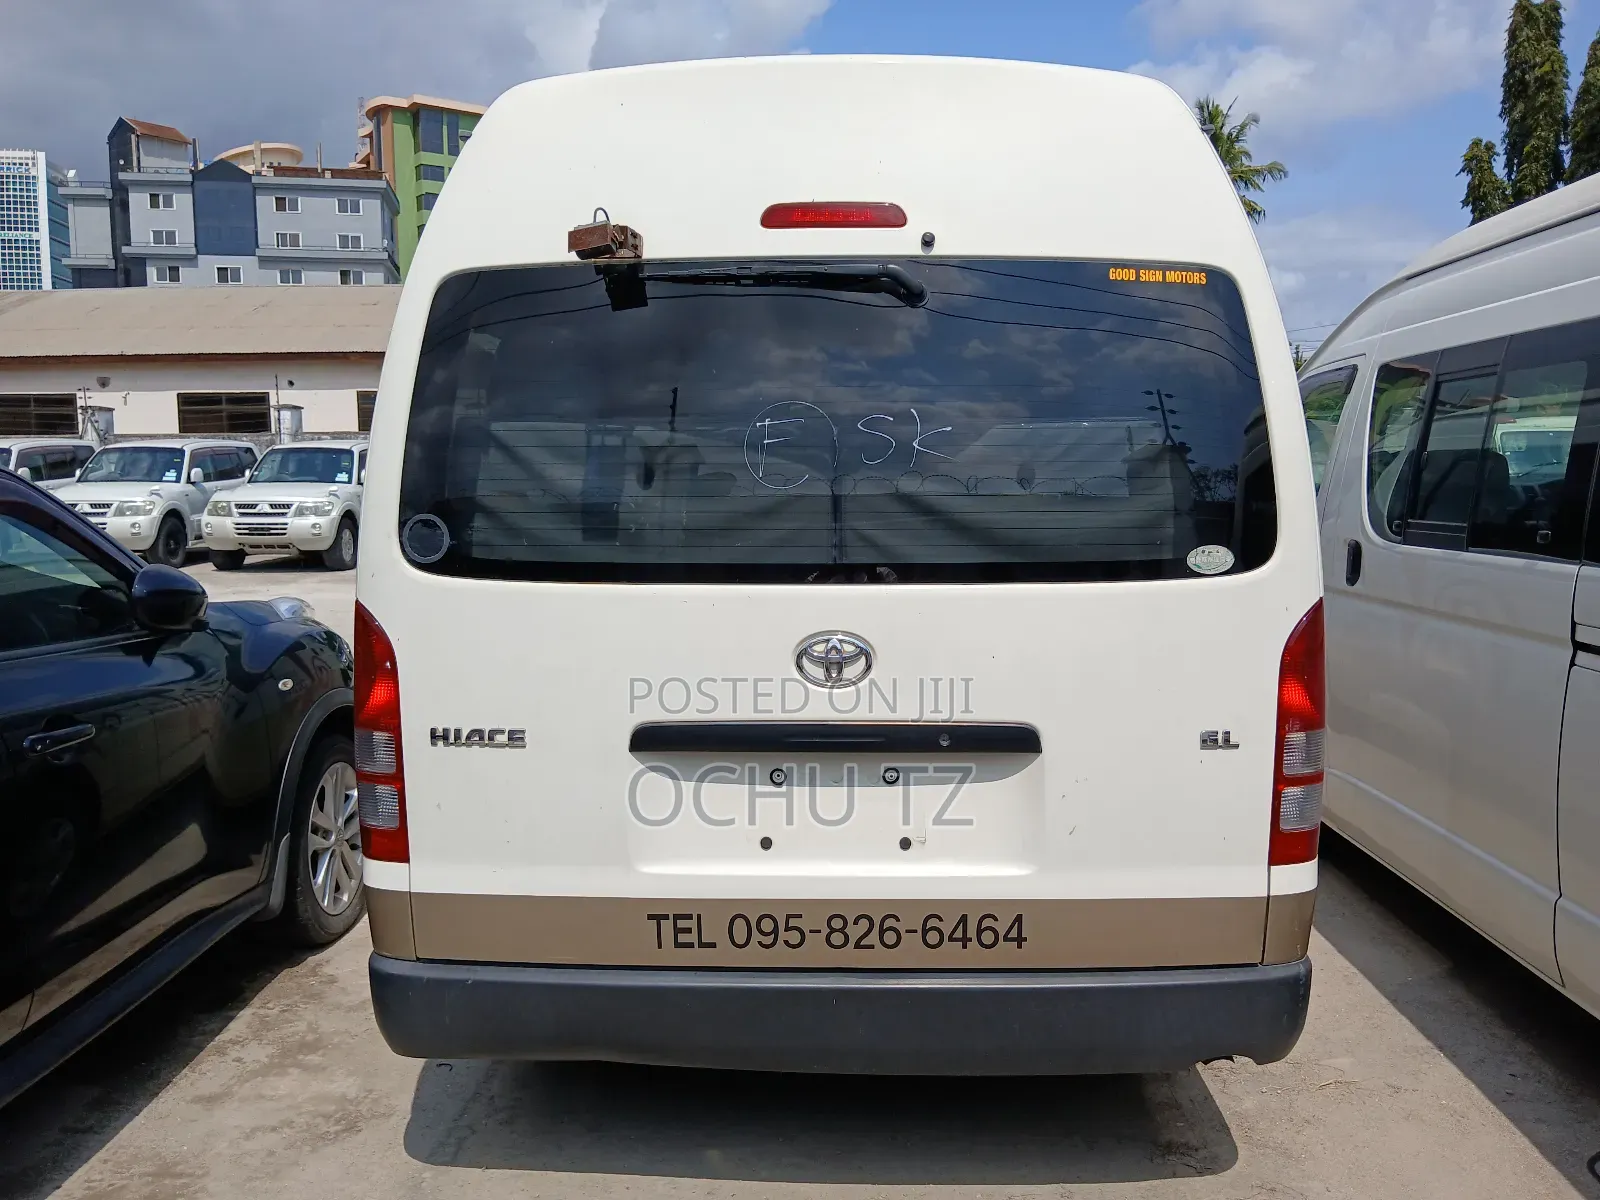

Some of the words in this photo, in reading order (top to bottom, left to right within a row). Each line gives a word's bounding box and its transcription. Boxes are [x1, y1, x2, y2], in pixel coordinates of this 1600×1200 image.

[1109, 267, 1136, 281] GOOD
[1139, 269, 1163, 282] SIGN
[1165, 270, 1207, 284] MOTORS
[430, 726, 527, 748] HIACE
[646, 913, 718, 949] TEL
[727, 913, 1028, 950] 095-826-6464
